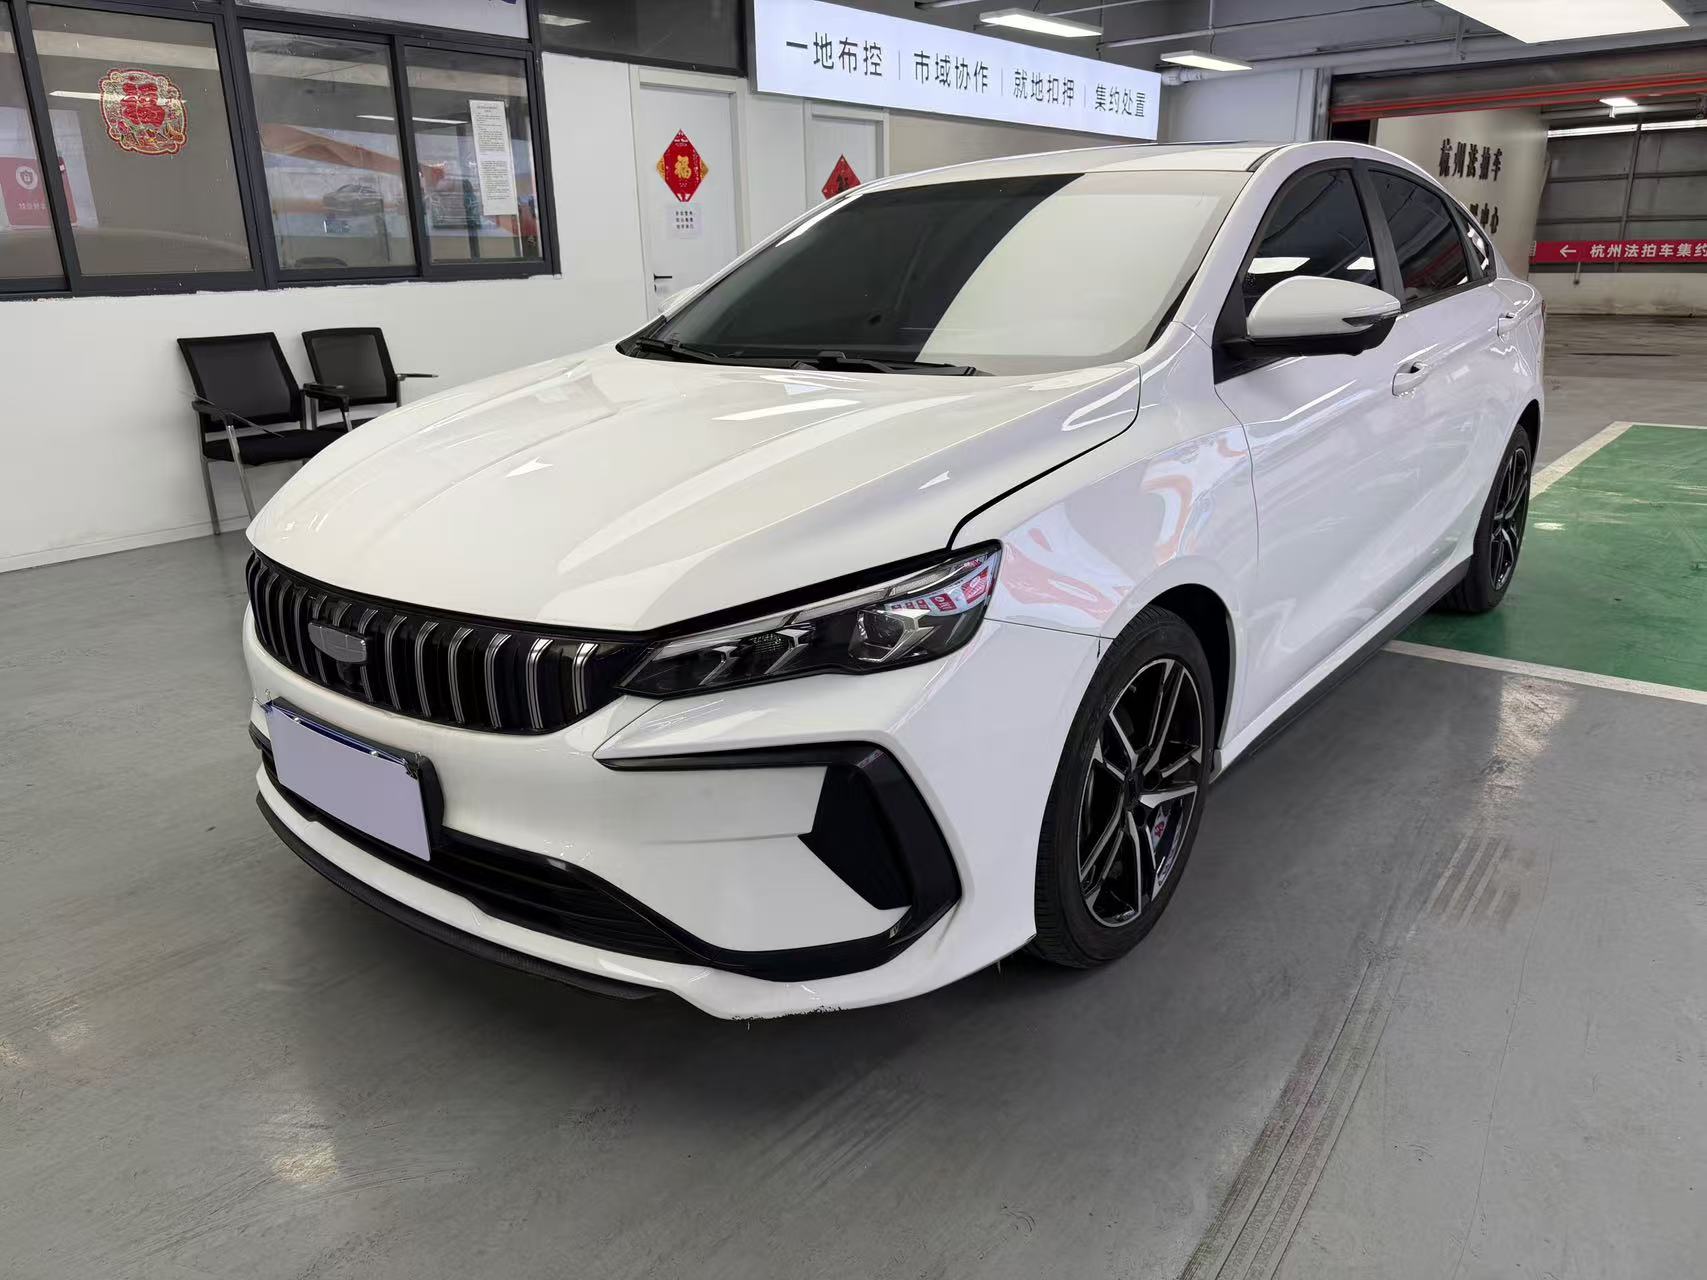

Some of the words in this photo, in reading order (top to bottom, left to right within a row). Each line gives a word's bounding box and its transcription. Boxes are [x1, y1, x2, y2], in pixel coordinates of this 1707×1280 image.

[786, 31, 883, 77] 一地布控
[913, 49, 989, 94] 市域协作
[1013, 68, 1075, 106] 就地扣押
[1095, 83, 1146, 118] 集约处置
[674, 155, 692, 179] 福
[1439, 138, 1503, 182] 杭州法拍车
[1590, 242, 1707, 258] 杭州法拍车集约
